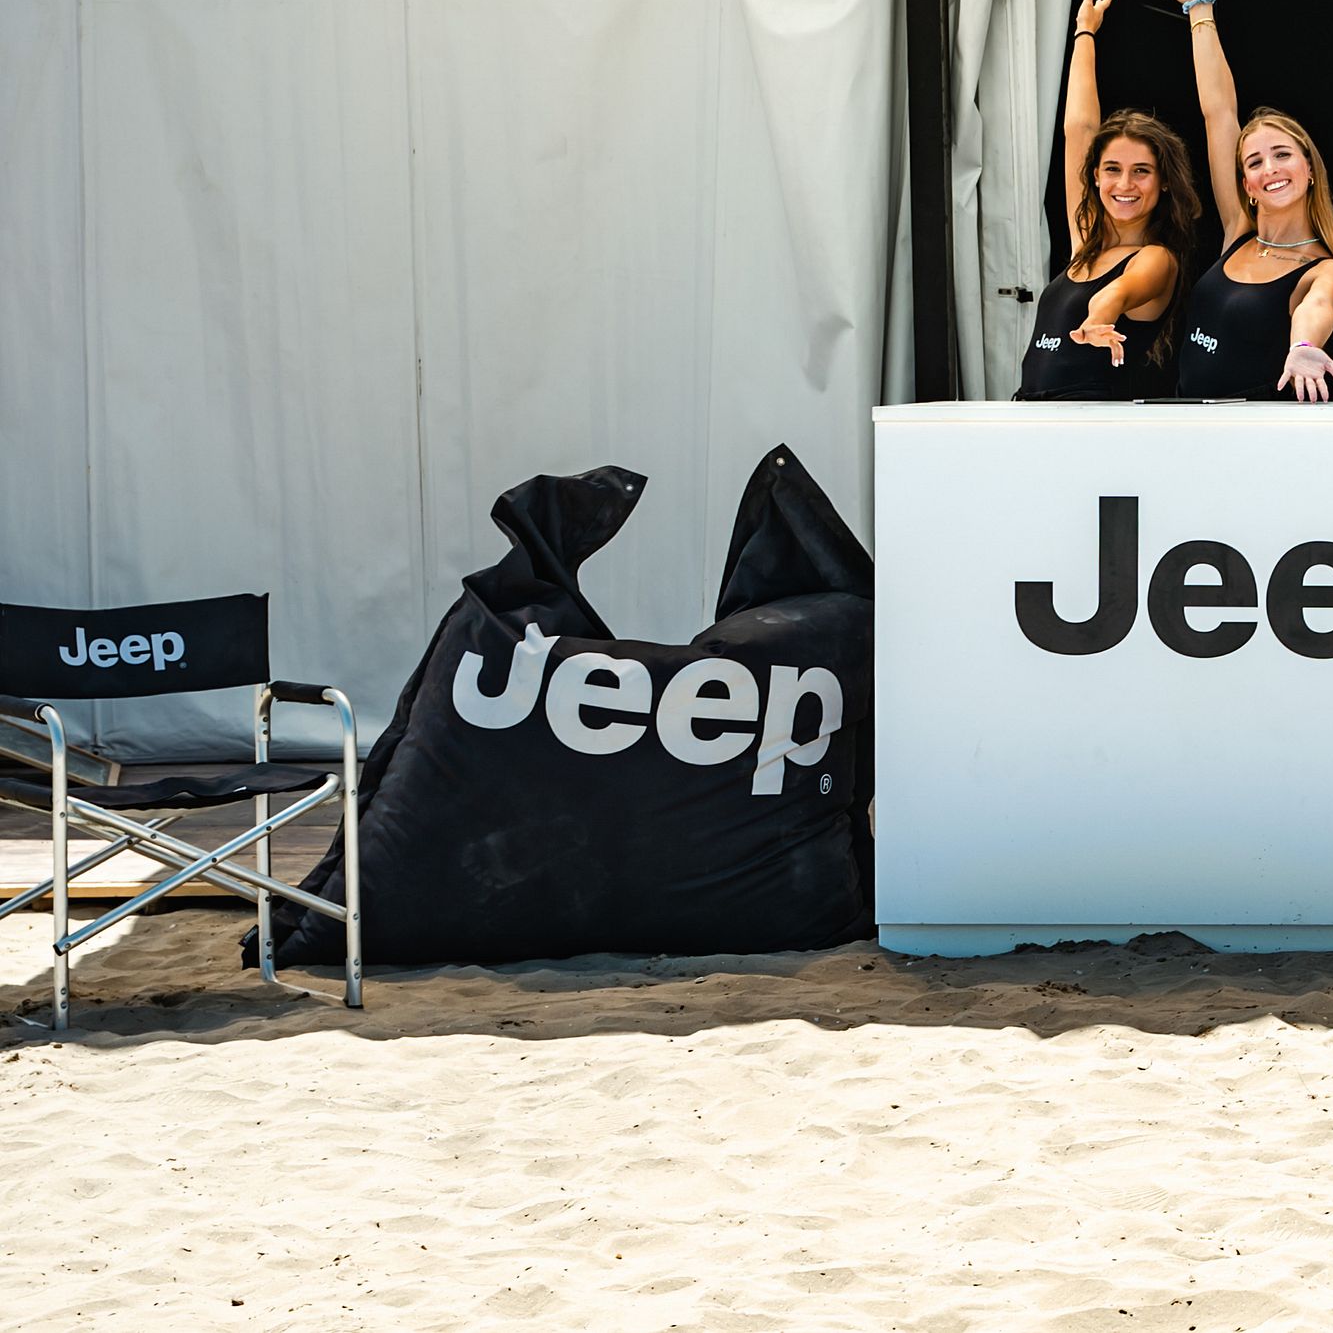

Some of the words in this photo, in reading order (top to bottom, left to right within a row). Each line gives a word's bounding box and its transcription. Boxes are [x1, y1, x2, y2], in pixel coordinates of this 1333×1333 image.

[1036, 333, 1062, 351] Jeep
[1190, 327, 1218, 353] Jeep
[60, 627, 185, 671] Jeep
[453, 622, 843, 795] Jeep
